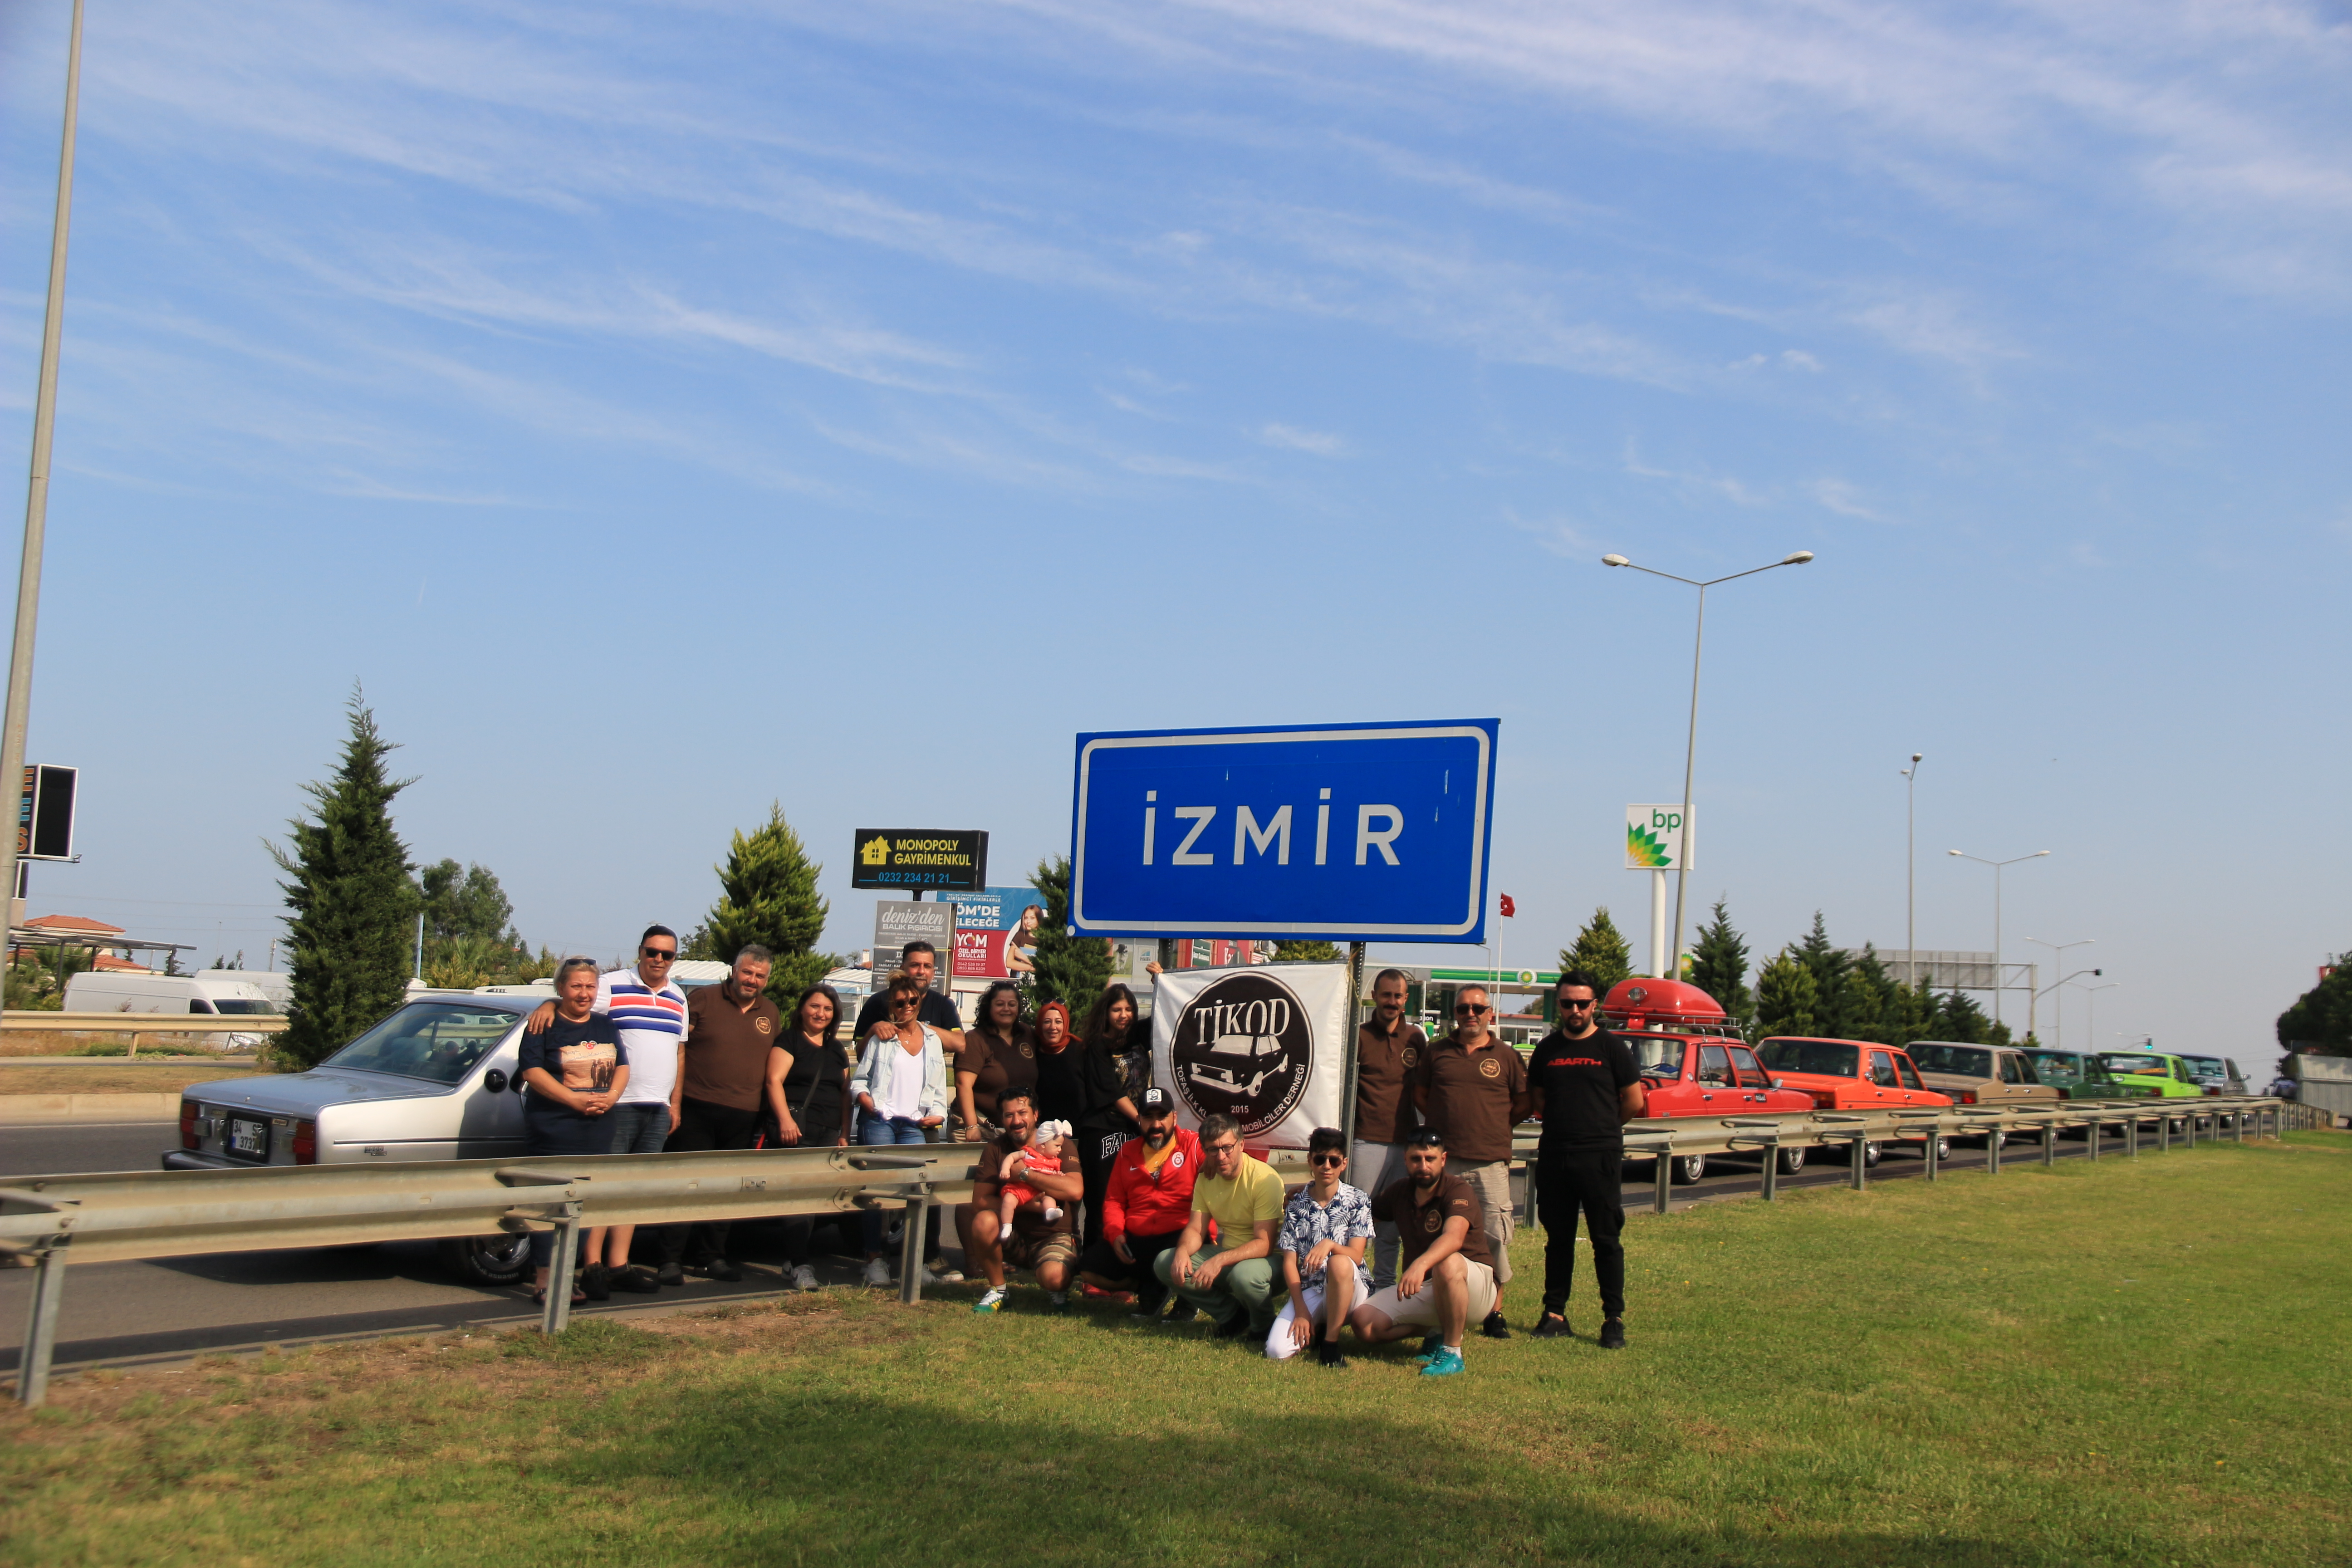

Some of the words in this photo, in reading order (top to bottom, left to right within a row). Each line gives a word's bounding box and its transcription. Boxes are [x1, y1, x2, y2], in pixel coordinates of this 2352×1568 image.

[1143, 788, 1404, 866] İZMİR
[1653, 808, 1682, 833] bp
[897, 839, 959, 851] MONOPOLY
[895, 851, 971, 865] GAYRİMENKUL
[879, 872, 901, 882] 0232
[904, 872, 921, 882] 234
[924, 873, 935, 882] 21
[939, 873, 949, 883] 21
[882, 906, 945, 925] deniz'den
[957, 902, 1000, 916] ÖM'DE
[956, 916, 1000, 927] ELECEĞE
[956, 932, 987, 947] YÖM
[1224, 947, 1234, 965] Ka
[1194, 998, 1290, 1045] TİKOD
[1547, 1057, 1602, 1066] ABARTH
[1176, 1064, 1190, 1094] TOFAŞ
[1187, 1093, 1199, 1109] İLK
[1198, 1106, 1207, 1118] KL
[1242, 1102, 1287, 1132] MOBİLCİLER
[1283, 1063, 1305, 1105] DERNEĞİ
[234, 1120, 242, 1134] 34
